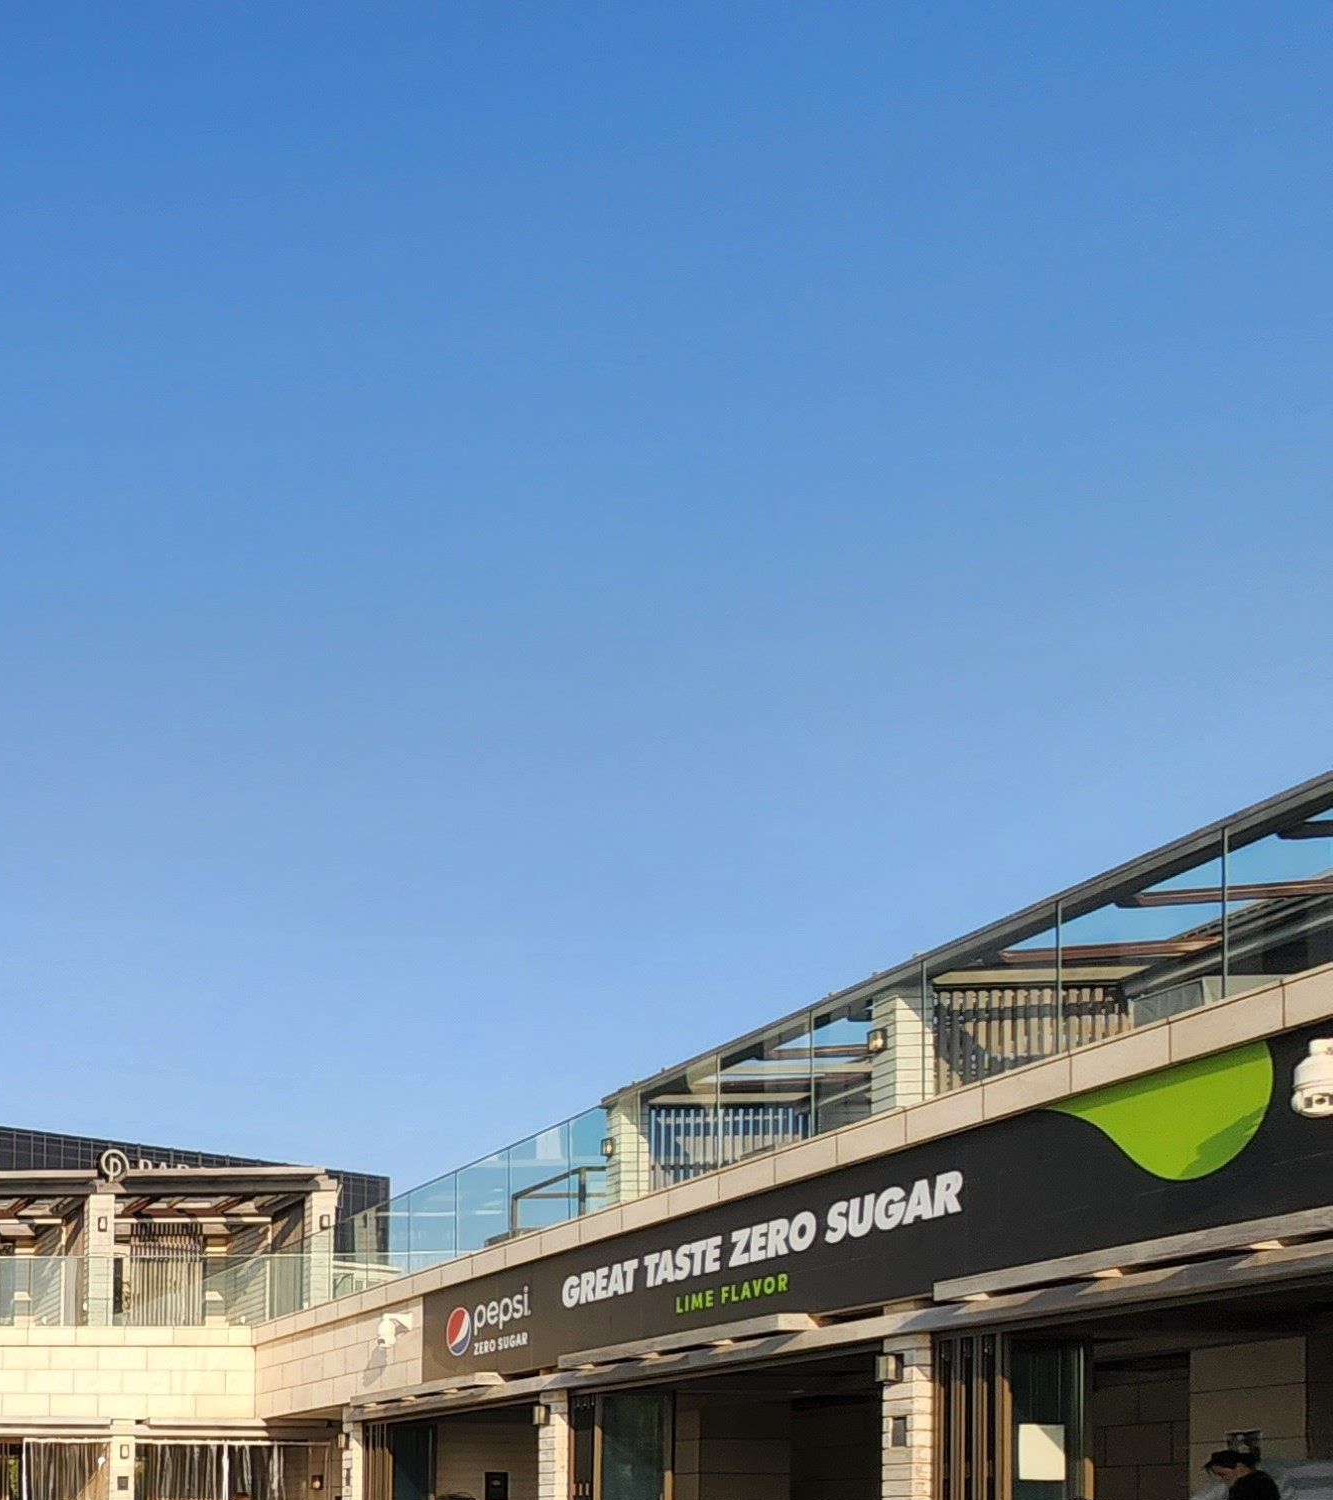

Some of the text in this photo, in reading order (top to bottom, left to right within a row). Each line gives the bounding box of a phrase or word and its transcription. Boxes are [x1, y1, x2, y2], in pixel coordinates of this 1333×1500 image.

[562, 1171, 963, 1309] GREAT TASTE ZERO SUGAR
[676, 1273, 788, 1313] LIME FLAVOR
[474, 1332, 528, 1355] ZERO SUGAR
